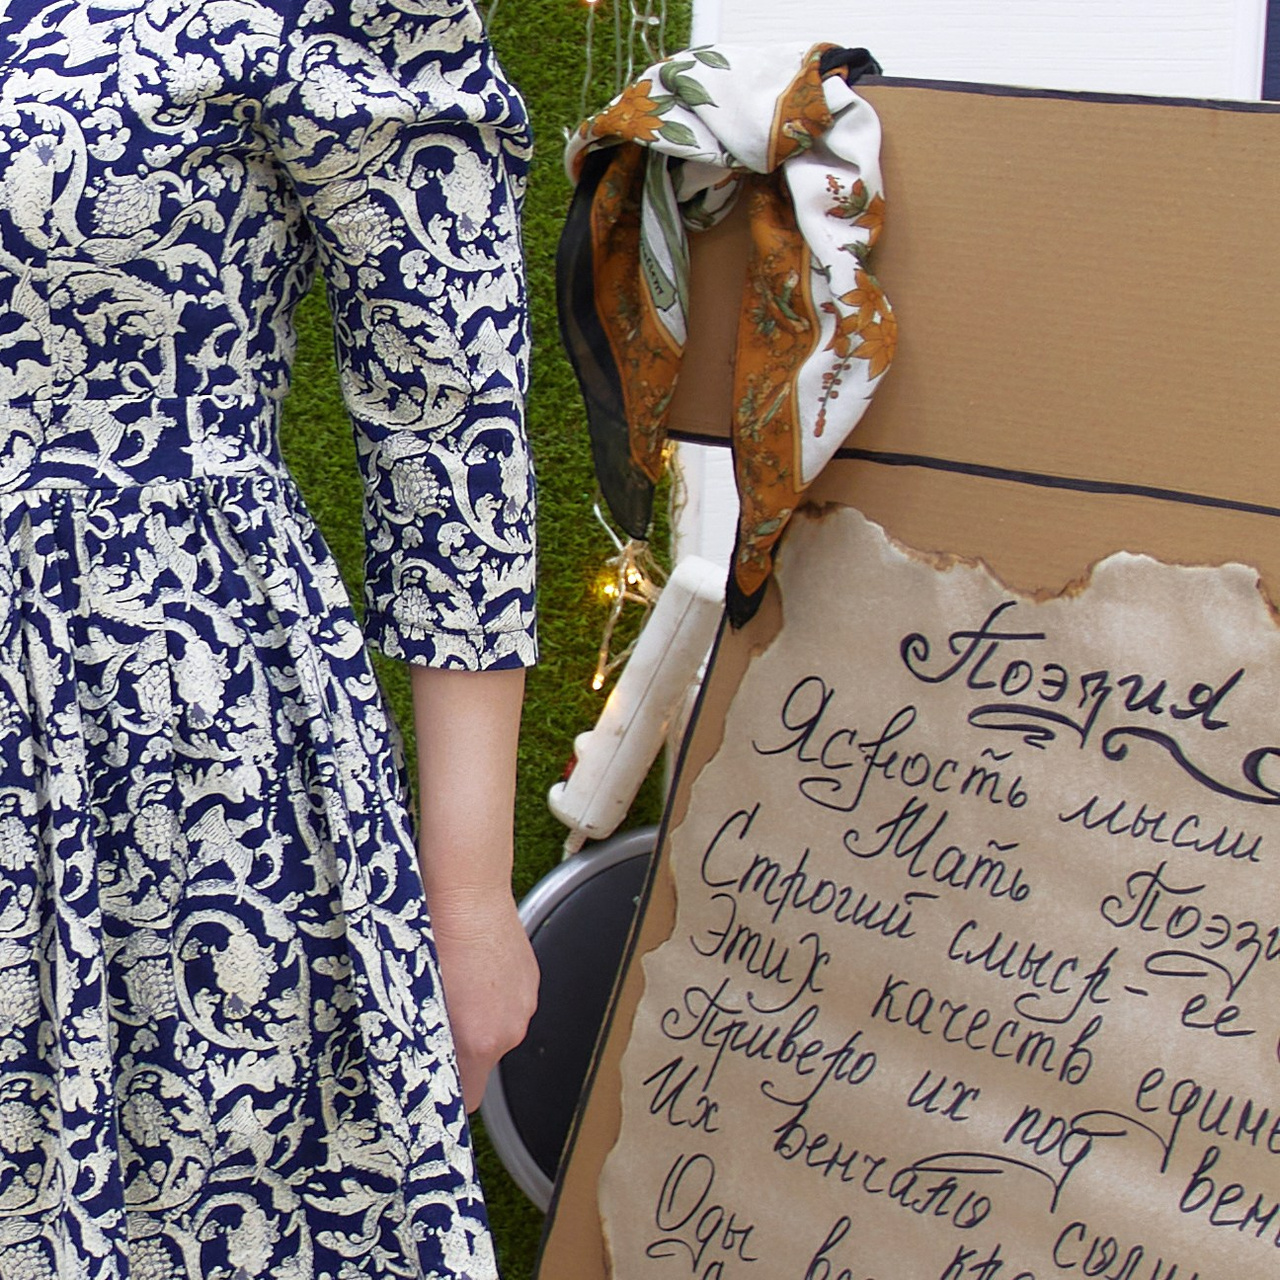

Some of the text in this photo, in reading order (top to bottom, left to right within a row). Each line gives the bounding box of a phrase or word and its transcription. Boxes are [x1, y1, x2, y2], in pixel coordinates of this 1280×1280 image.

[901, 601, 1245, 748] Поэзия
[753, 675, 1264, 863] Ясность мысли
[843, 796, 1031, 901] Мать
[701, 803, 940, 939] Строгий
[691, 893, 831, 1011] Этих
[871, 974, 1103, 1085] качеств
[642, 1056, 720, 1133] Их
[773, 1103, 994, 1229] венчало
[646, 1154, 758, 1273] Оды
[907, 1070, 981, 1122] их
[1003, 1102, 1105, 1214] под
[1179, 1144, 1280, 1250] вен
